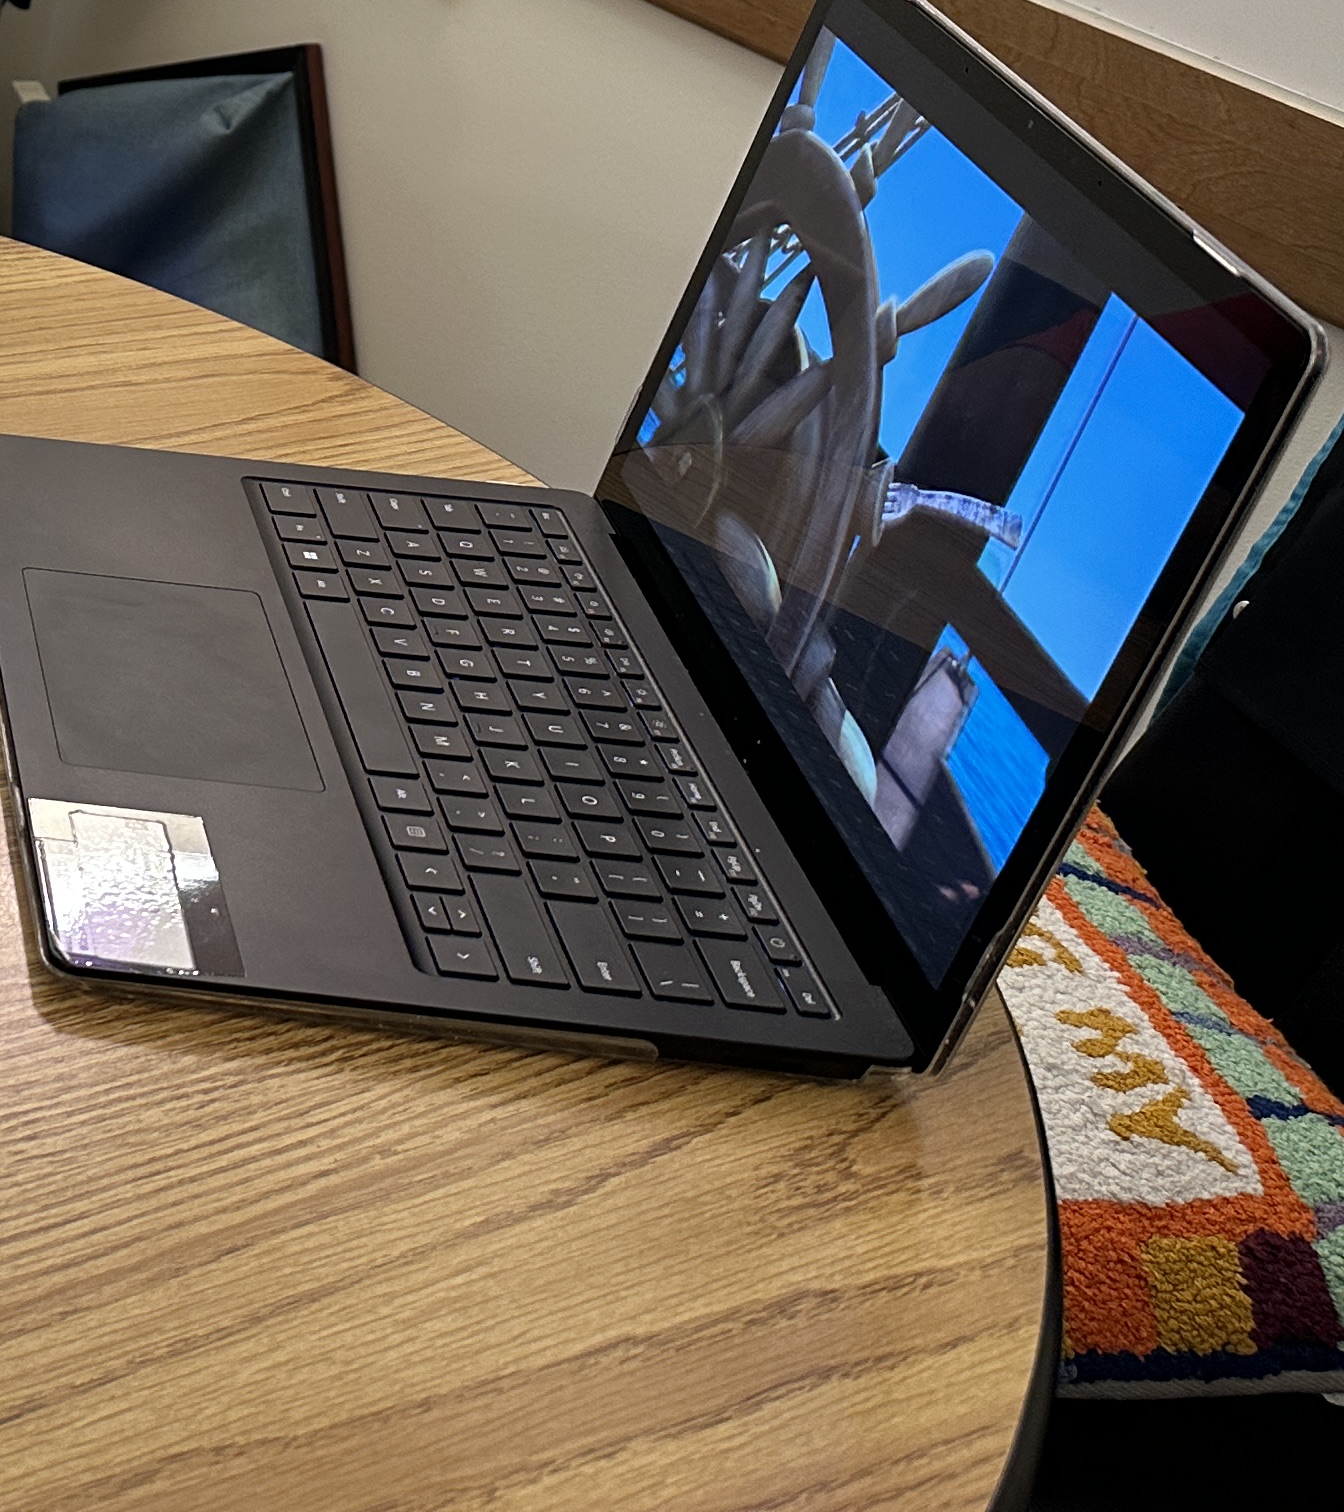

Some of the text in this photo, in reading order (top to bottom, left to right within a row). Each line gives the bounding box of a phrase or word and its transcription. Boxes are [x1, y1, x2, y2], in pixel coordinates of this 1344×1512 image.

[389, 498, 399, 510] Caps
[356, 549, 371, 557] Z
[473, 568, 488, 578] W
[368, 577, 383, 585] X
[431, 598, 446, 606] D
[380, 607, 395, 615] C
[393, 638, 408, 646] V
[459, 659, 474, 667] G
[584, 657, 597, 665] %
[406, 669, 421, 677] B
[474, 691, 489, 700] H
[420, 702, 435, 711] N
[488, 725, 504, 733] J
[548, 725, 564, 734] U
[434, 735, 450, 746] M
[505, 760, 520, 769] K
[581, 795, 598, 805] O
[631, 792, 645, 800] 9
[651, 830, 665, 838] 0
[600, 835, 617, 843] P
[527, 956, 543, 974] Shift
[596, 961, 613, 981] Enter
[730, 960, 756, 998] Backspace
[801, 992, 816, 1005] Del
